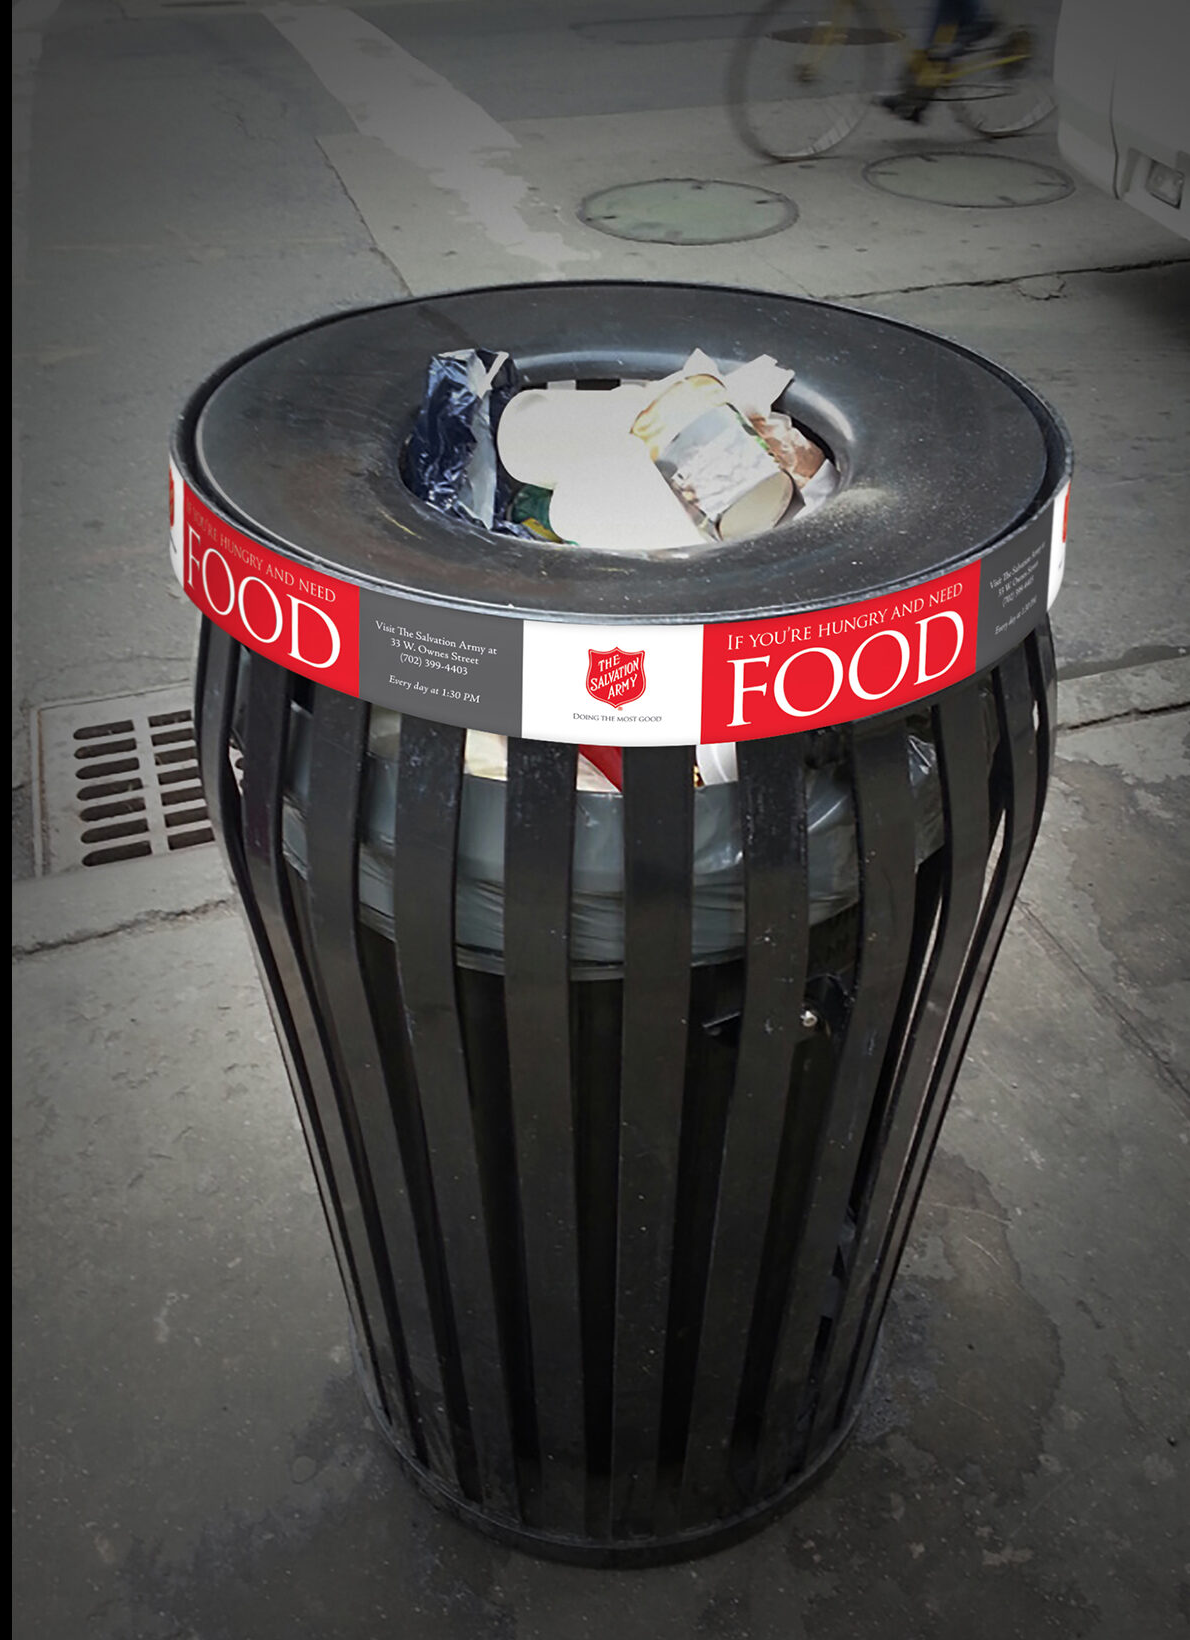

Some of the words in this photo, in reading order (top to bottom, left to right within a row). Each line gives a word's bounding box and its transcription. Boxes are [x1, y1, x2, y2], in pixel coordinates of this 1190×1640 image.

[220, 534, 263, 571] HUNGRY
[266, 564, 294, 586] AND
[299, 578, 336, 602] NEED
[187, 521, 341, 669] FOOD
[727, 634, 744, 650] IF
[749, 626, 812, 648] YOU'RE
[818, 608, 888, 637] HUNGRY
[891, 598, 925, 620] AND
[928, 582, 963, 608] NEED
[375, 620, 395, 634] Visit
[397, 626, 414, 638] The
[415, 631, 457, 648] Salvation
[459, 640, 486, 655] Army
[487, 647, 498, 655] at
[390, 637, 401, 647] 33
[403, 640, 416, 652] W.
[418, 645, 449, 659] Ownes
[451, 652, 479, 665] Street
[400, 652, 422, 667] (702)
[425, 659, 468, 676] 399-4403
[590, 657, 639, 691] SALVATION
[598, 654, 620, 672] THE
[727, 610, 964, 727] FOOD
[389, 674, 412, 690] Every
[413, 681, 428, 694] day
[430, 687, 439, 695] at
[442, 688, 461, 700] 1:30
[463, 692, 481, 703] PM
[607, 674, 638, 700] ARMY
[573, 712, 600, 721] DOING
